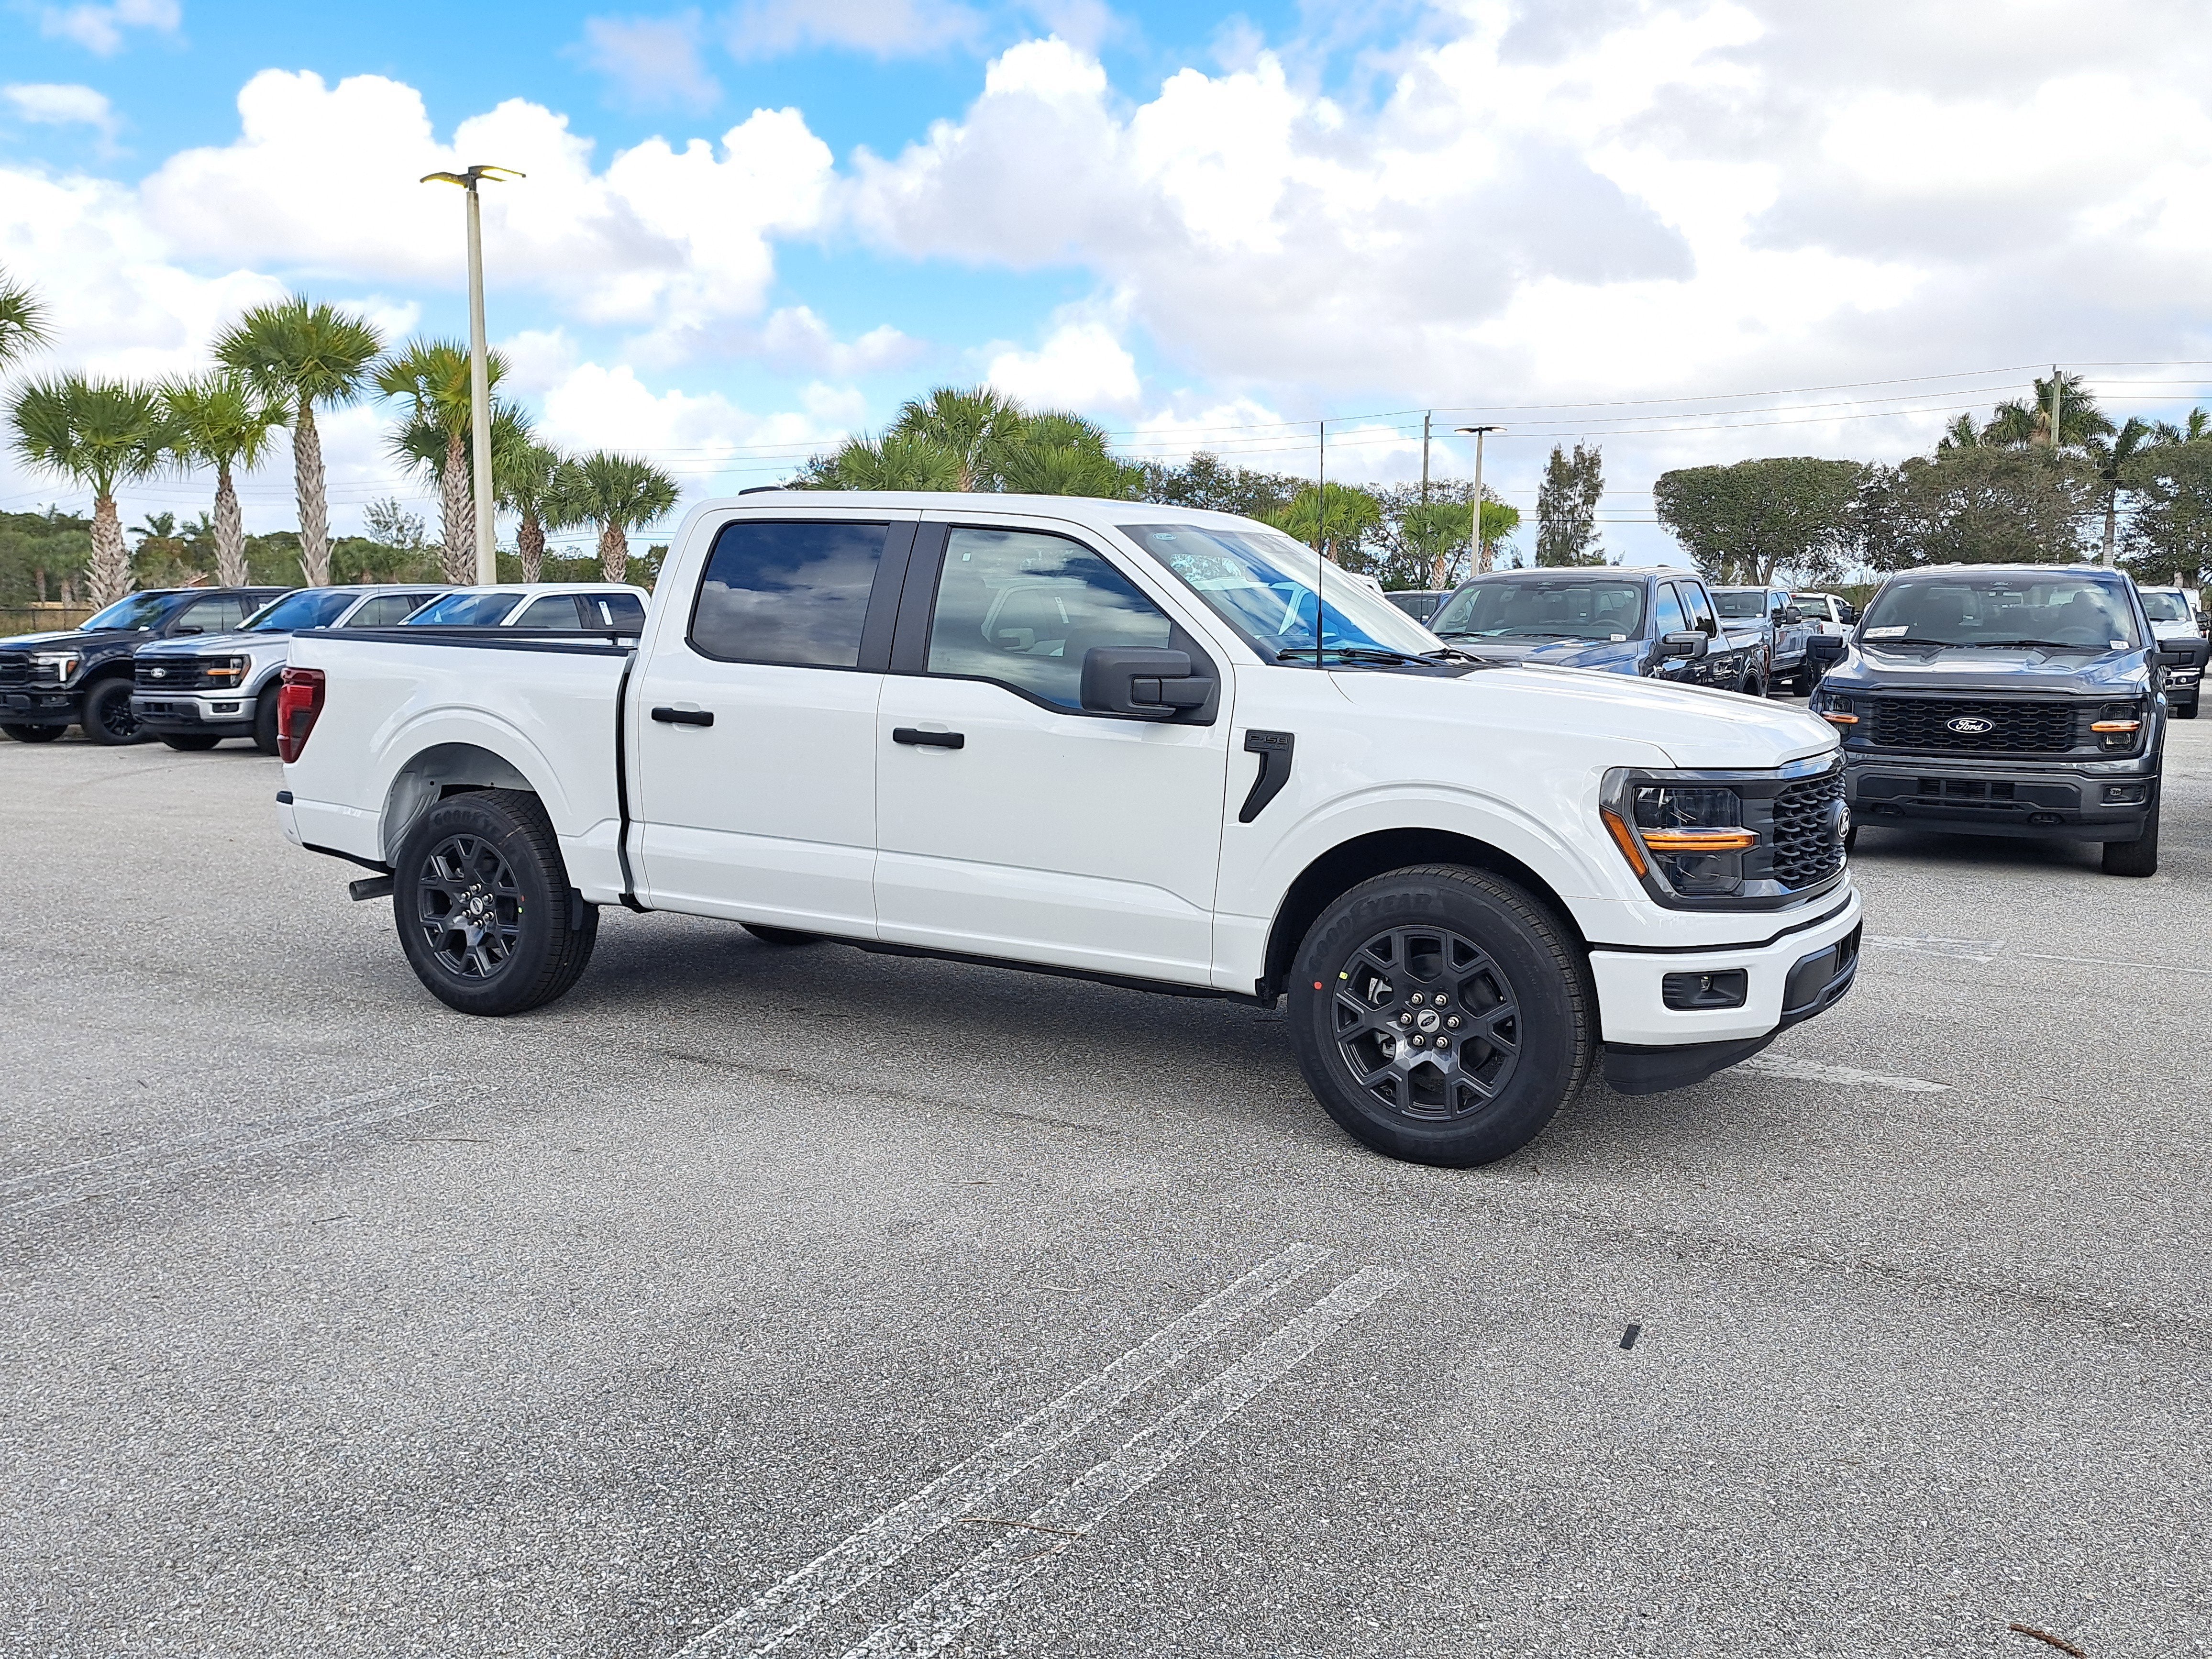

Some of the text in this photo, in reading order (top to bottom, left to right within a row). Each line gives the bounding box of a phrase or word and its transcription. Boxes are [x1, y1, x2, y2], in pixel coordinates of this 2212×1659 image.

[1956, 719, 1984, 730] Ford
[1248, 734, 1288, 745] F-150
[1309, 894, 1431, 973] GOODYEAR
